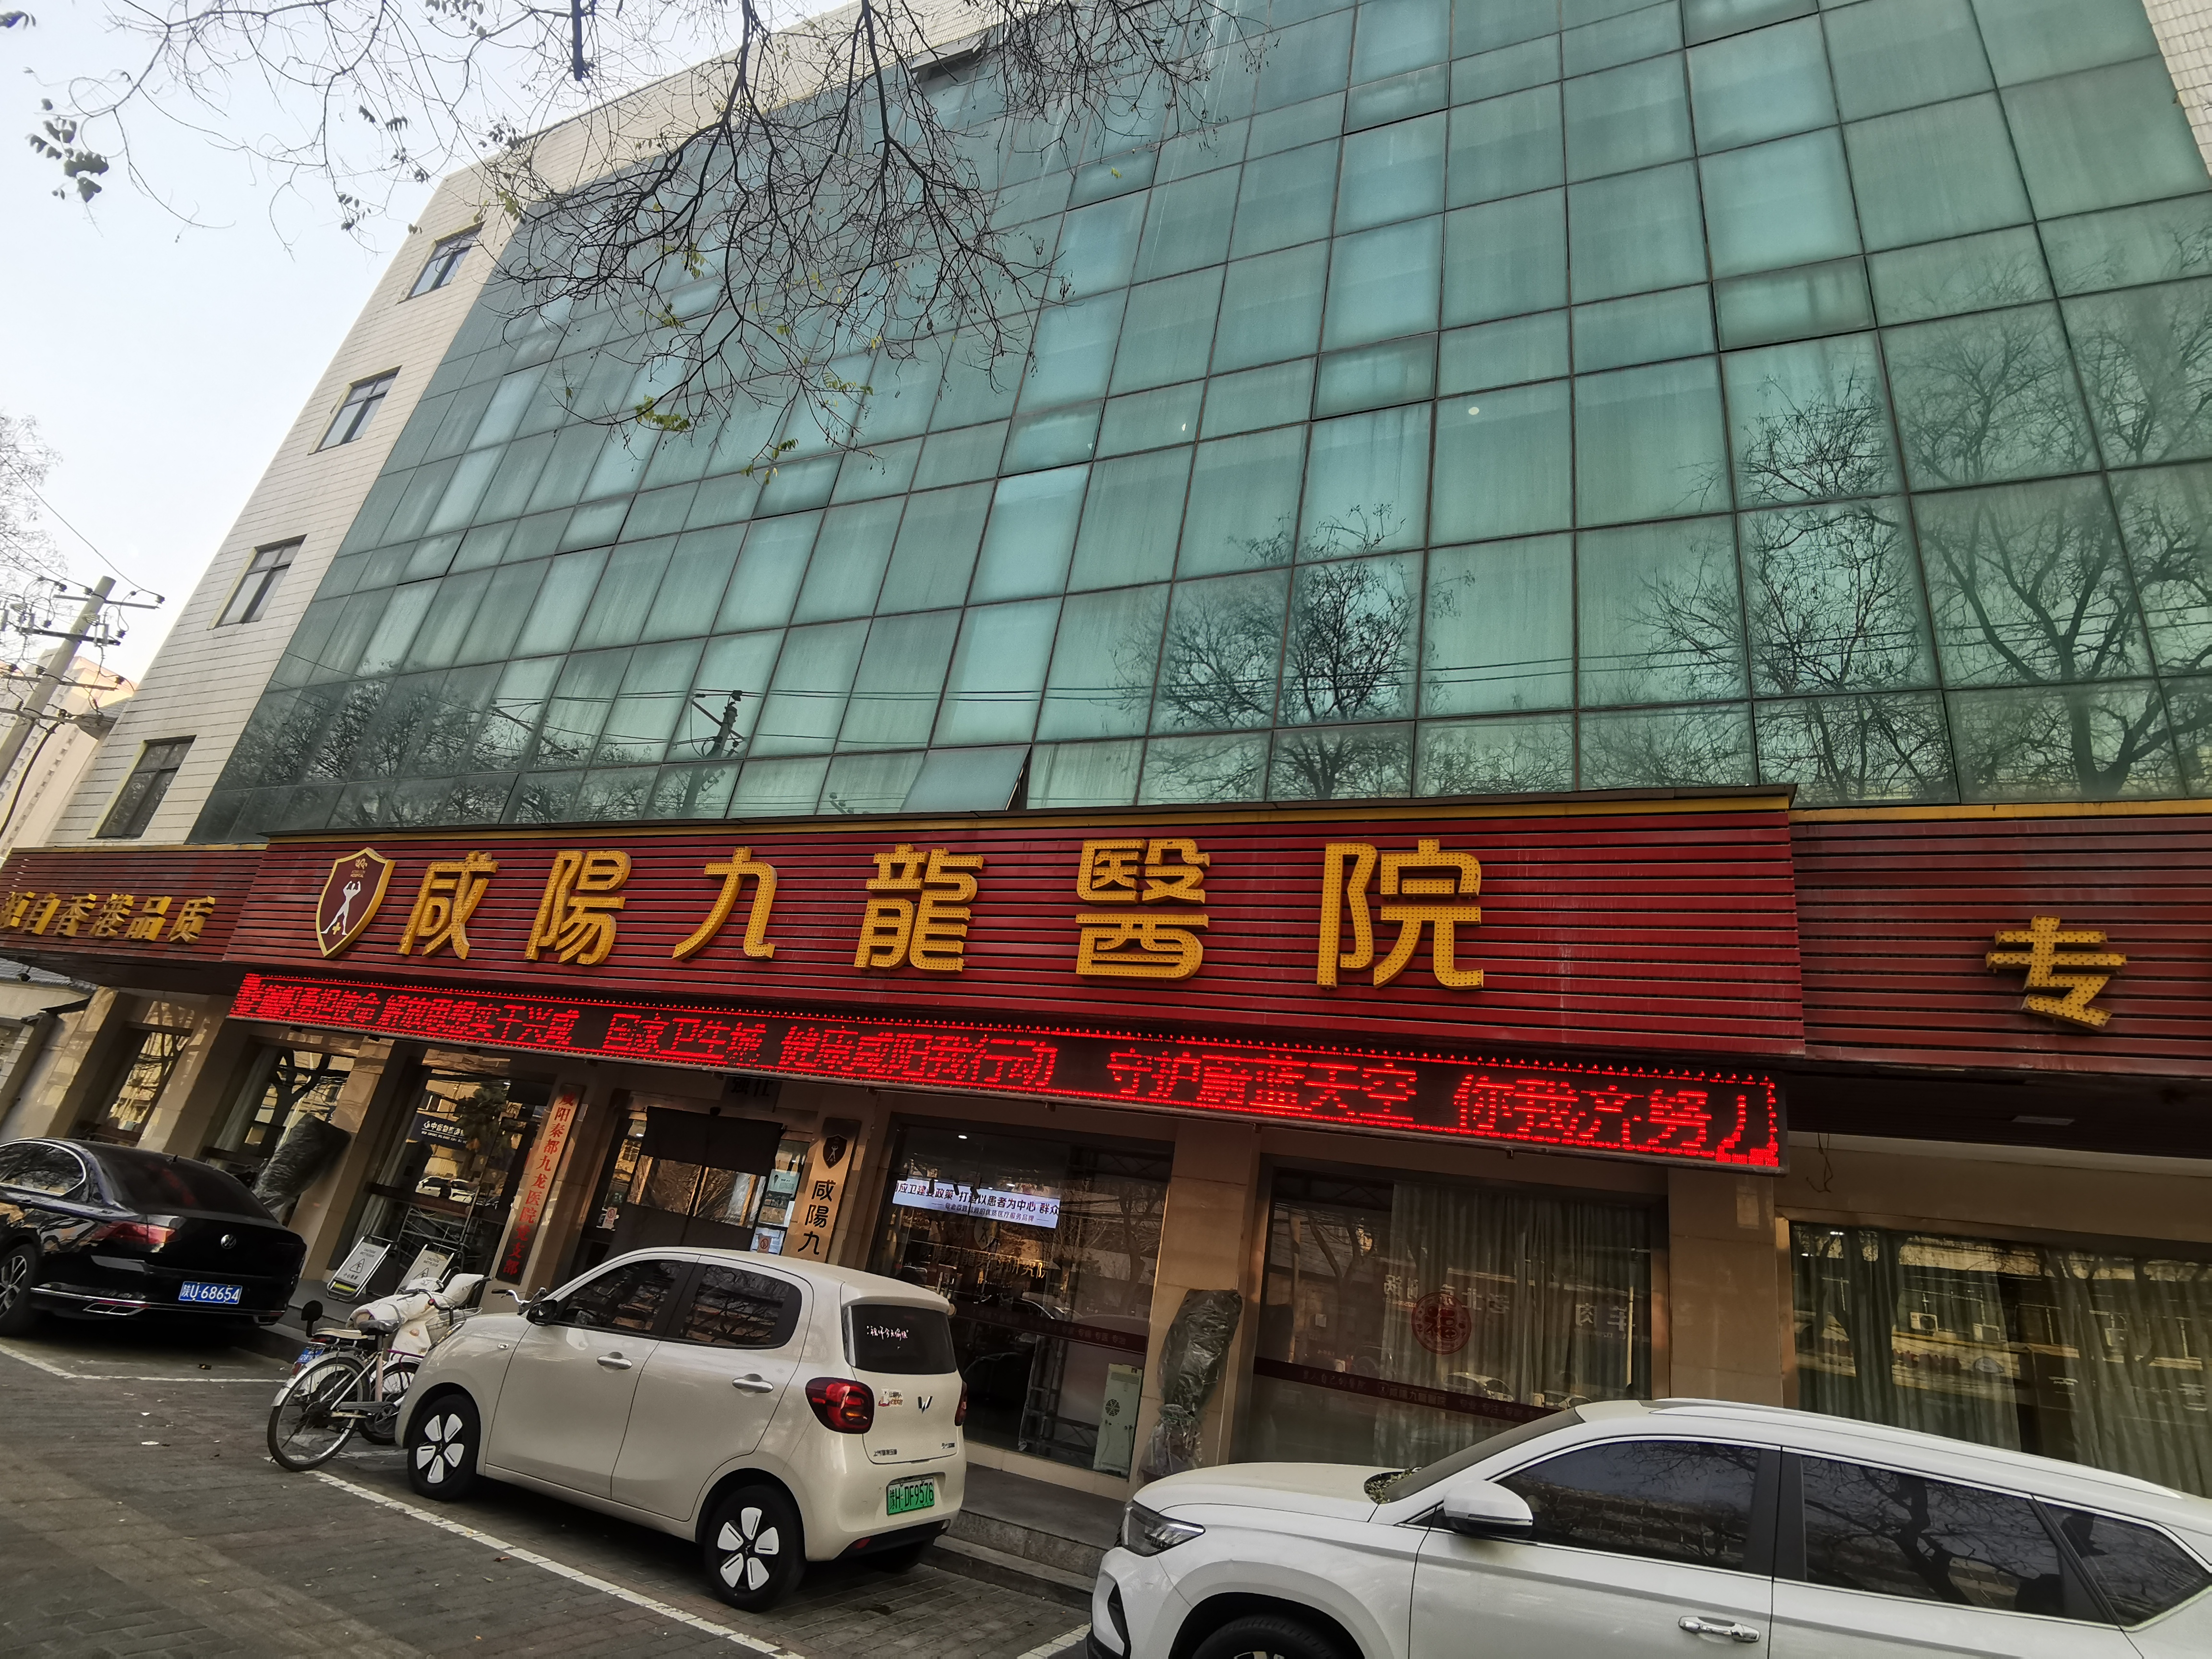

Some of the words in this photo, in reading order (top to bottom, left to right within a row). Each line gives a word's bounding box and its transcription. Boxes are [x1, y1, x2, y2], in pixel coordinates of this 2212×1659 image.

[397, 839, 1484, 989] 咸陽九龍醫院
[1985, 915, 2127, 1032] 专
[1106, 1048, 1418, 1122] 守护蔚蓝天空
[503, 1092, 577, 1276] 咸阳秦都九龙医院党支部
[797, 1179, 836, 1255] 咸陽九
[895, 1182, 954, 1201] 应卫建委政策
